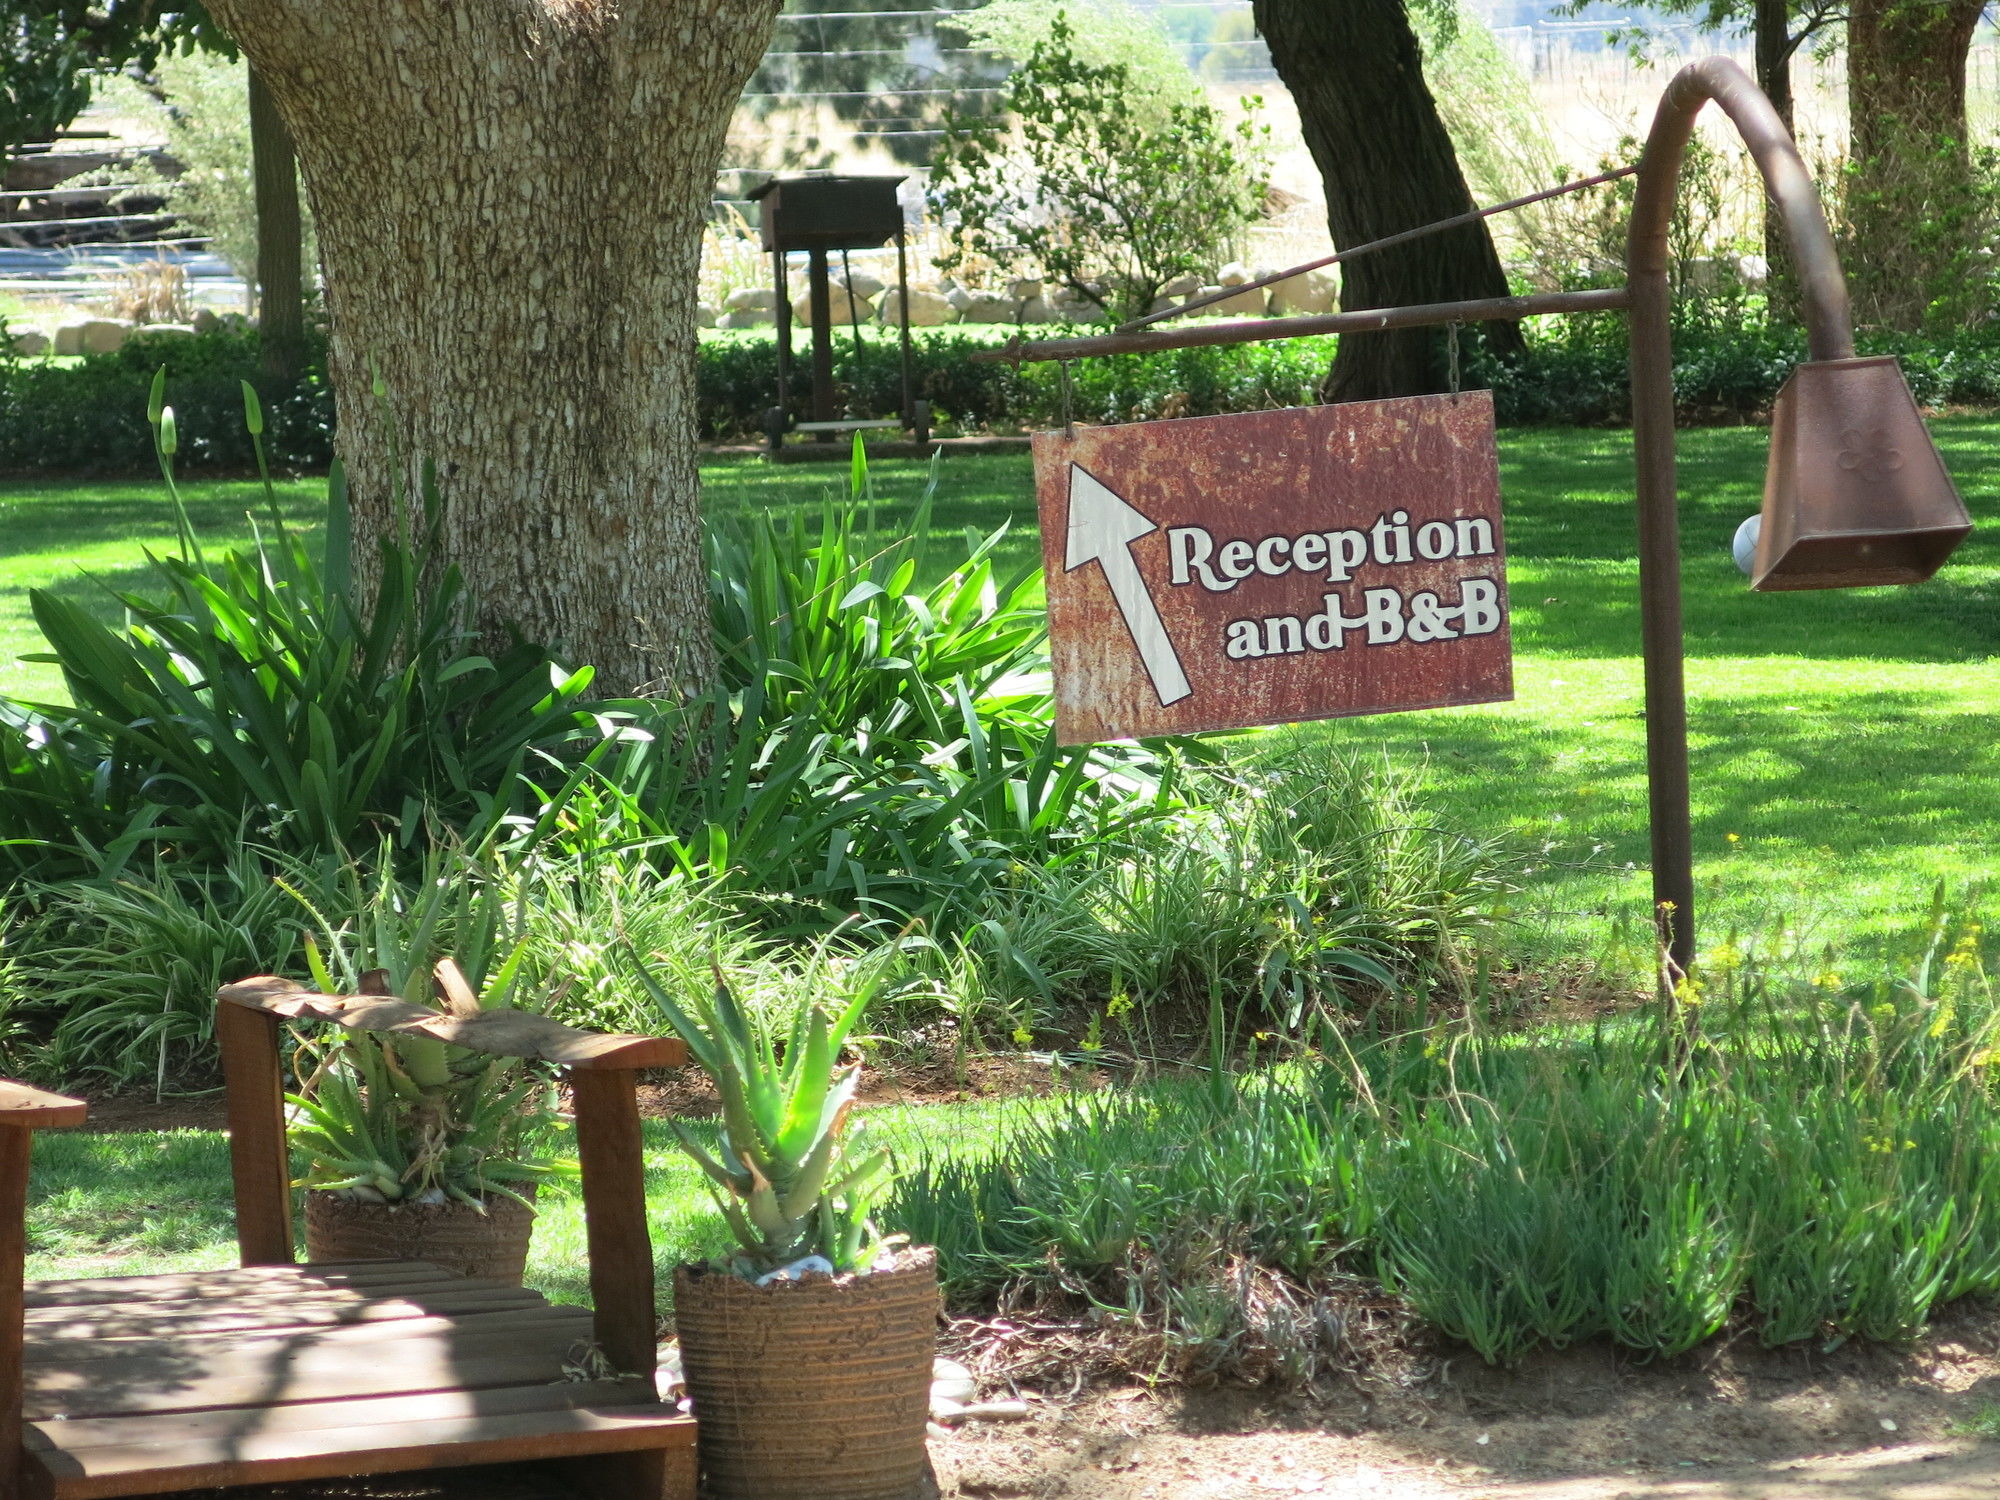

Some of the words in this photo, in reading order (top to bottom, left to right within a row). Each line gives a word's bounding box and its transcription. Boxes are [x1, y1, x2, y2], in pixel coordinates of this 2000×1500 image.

[1168, 509, 1495, 592] Reception
[1226, 593, 1346, 660] and
[1363, 578, 1501, 645] B&B
